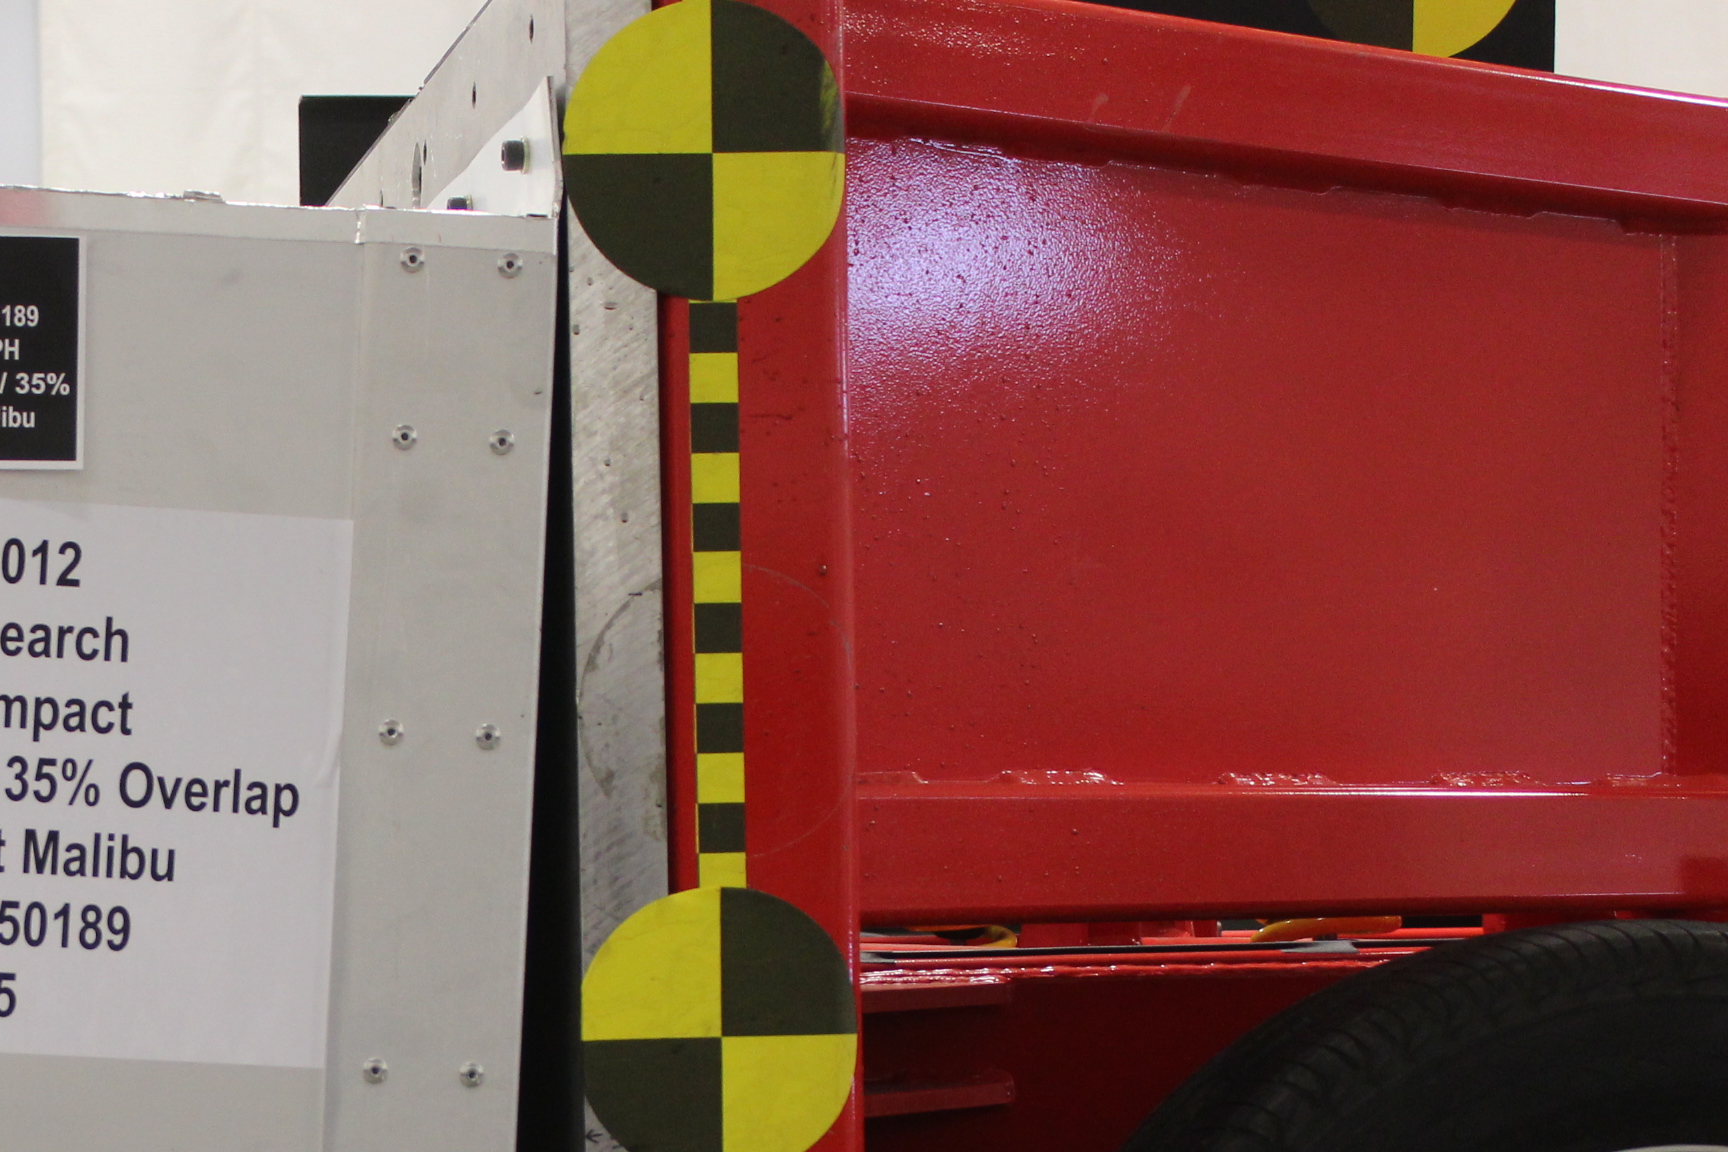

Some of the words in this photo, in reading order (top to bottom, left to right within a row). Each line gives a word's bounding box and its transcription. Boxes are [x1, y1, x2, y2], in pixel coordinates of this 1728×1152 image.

[16, 373, 69, 395] 35%
[5, 756, 100, 806] 35%
[119, 762, 299, 828] Overlap
[23, 829, 175, 882] Malibu
